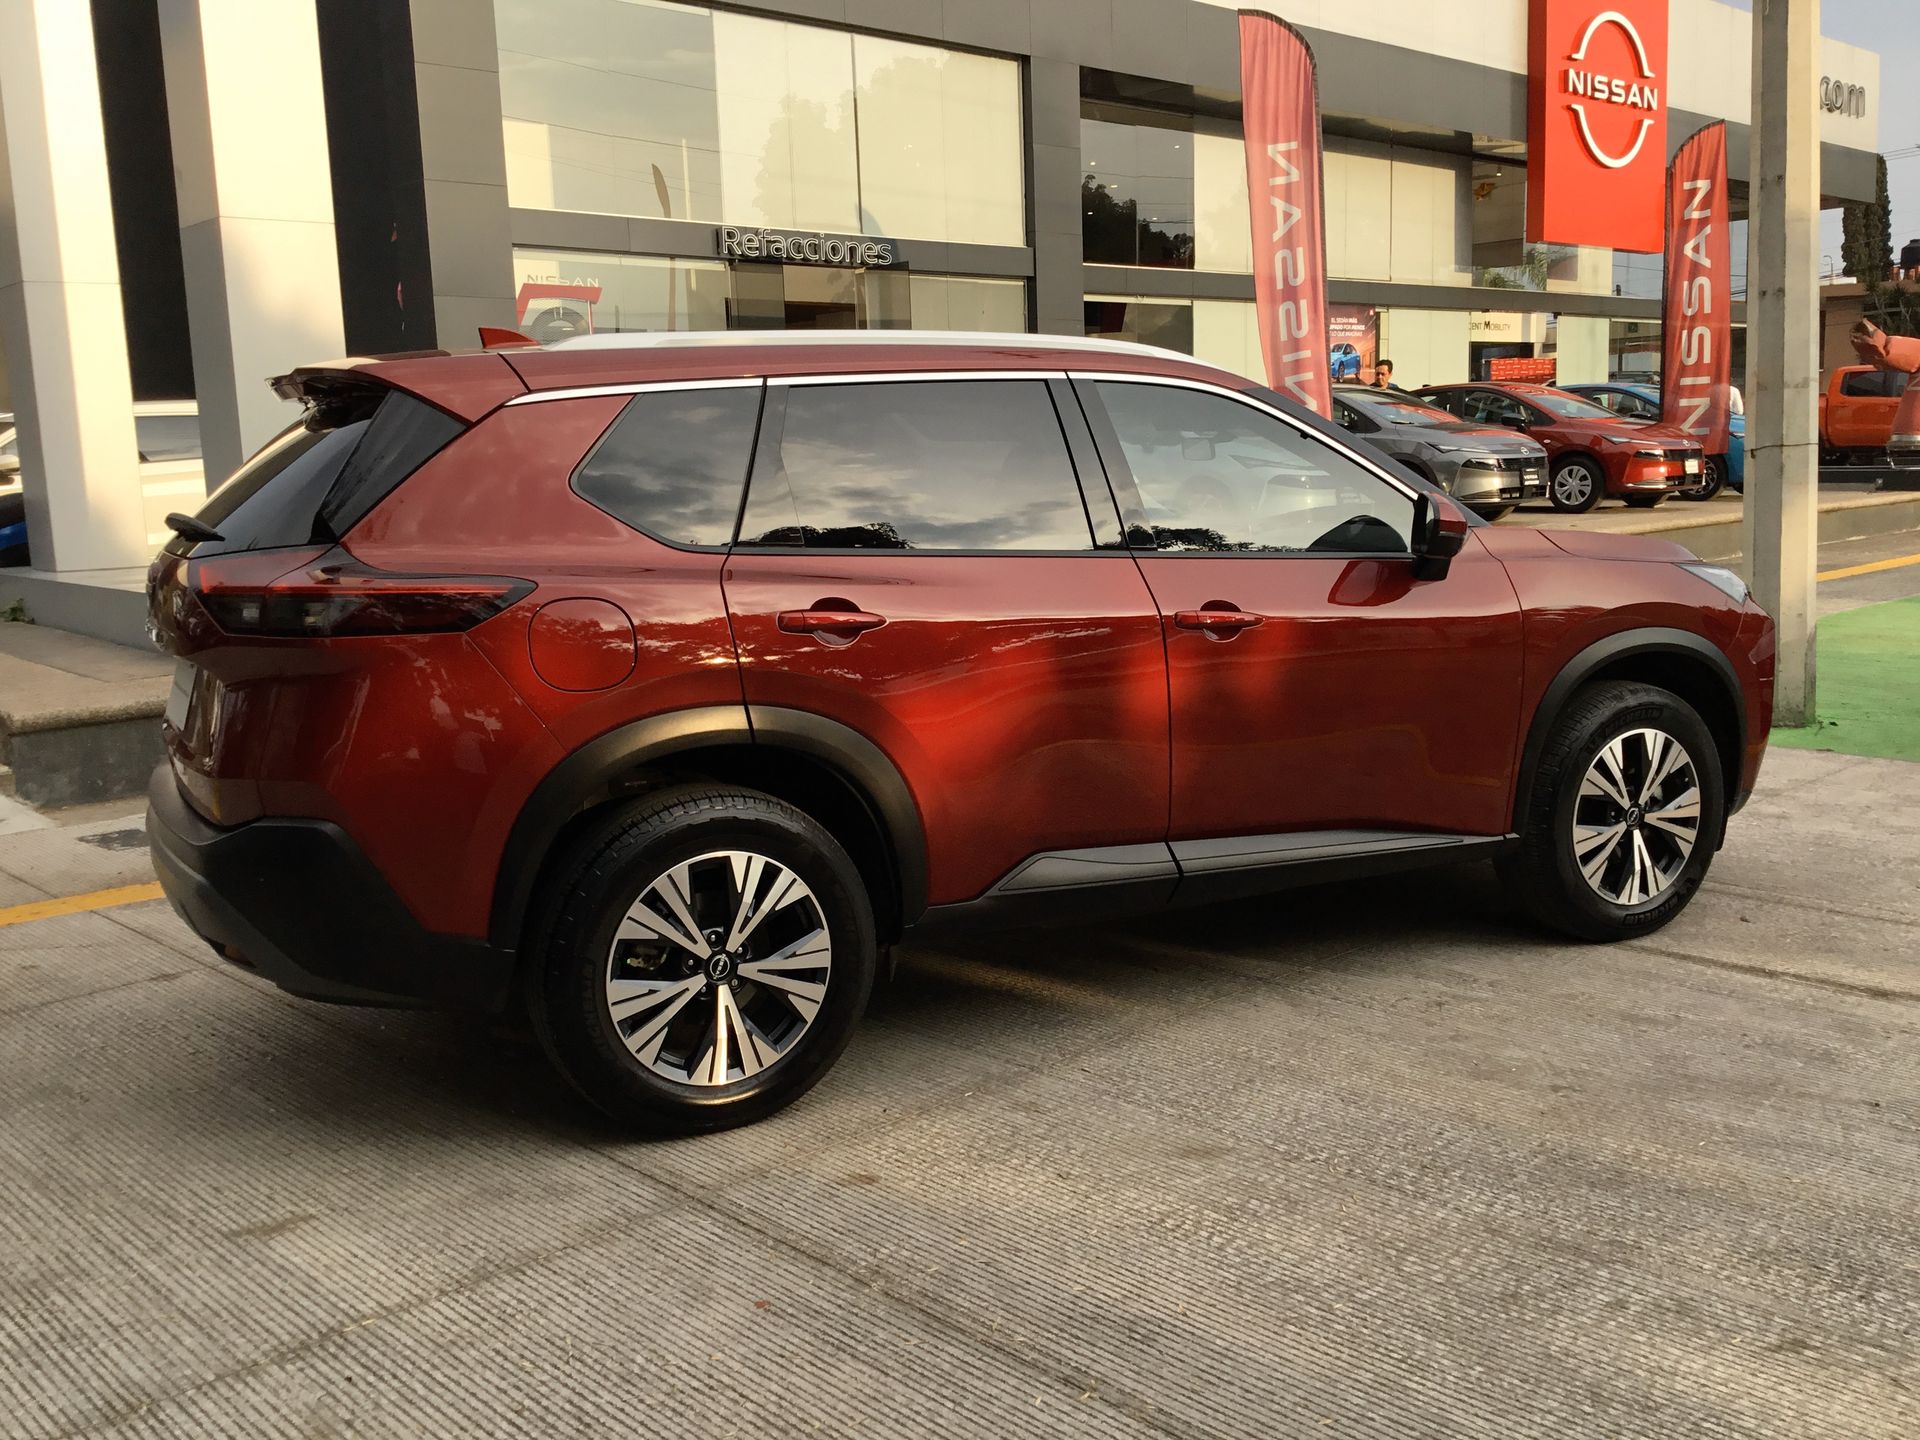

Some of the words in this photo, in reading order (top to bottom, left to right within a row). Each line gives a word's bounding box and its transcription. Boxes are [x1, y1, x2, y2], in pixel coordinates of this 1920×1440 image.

[1568, 67, 1658, 111] NISSAN
[721, 225, 893, 265] Refacciones
[1678, 178, 1712, 436] NISSAN
